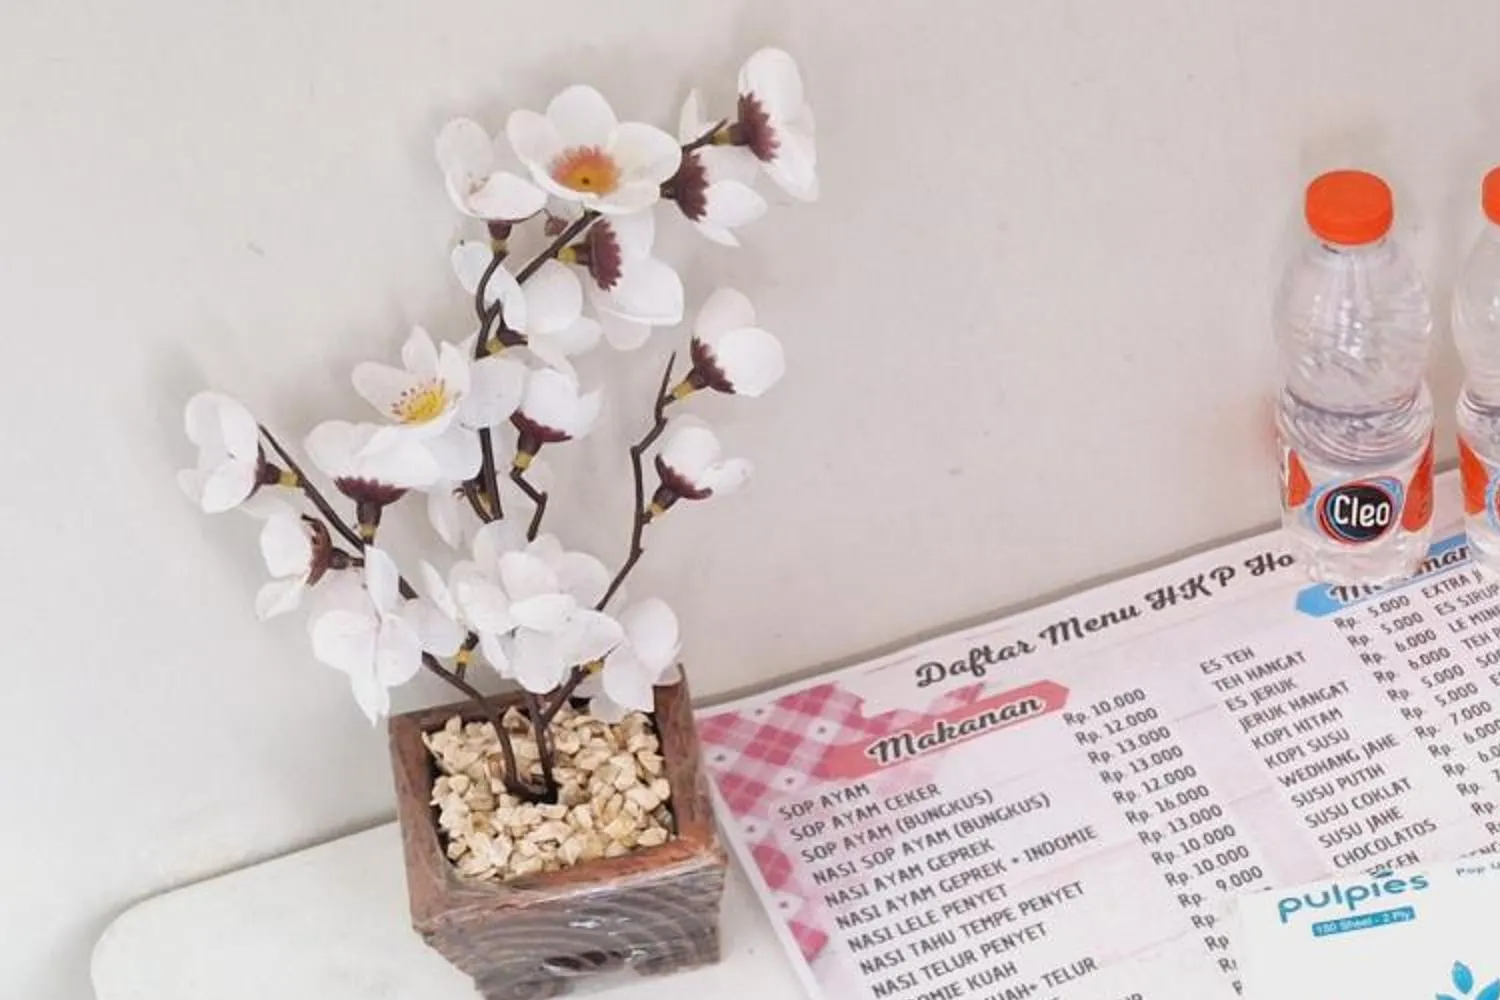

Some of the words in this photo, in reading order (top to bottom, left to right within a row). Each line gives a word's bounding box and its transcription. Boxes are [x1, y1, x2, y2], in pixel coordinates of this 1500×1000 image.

[1334, 495, 1389, 527] Cleo
[1421, 574, 1470, 599] EXTRA
[1433, 601, 1456, 616] ES
[1456, 583, 1500, 607] SIRUP
[1447, 617, 1468, 633] LE
[1460, 631, 1492, 650] TEH
[914, 641, 1036, 688] Daftar
[1039, 602, 1143, 647] Menu
[1199, 659, 1222, 675] ES
[1223, 647, 1255, 665] TEH
[1211, 673, 1244, 692] TEH
[1244, 651, 1305, 680] HANGAT
[1090, 688, 1146, 716] 10.000
[1224, 695, 1248, 712] ES
[1249, 677, 1297, 706] JERUK
[1238, 704, 1287, 733] JERUK
[1287, 680, 1348, 711] HANGAT
[867, 695, 1043, 764] Makanan
[1104, 707, 1158, 735] 12.000
[1116, 726, 1171, 754] 13.000
[1251, 726, 1292, 749] KOPI
[1292, 707, 1343, 733] HITAM
[1129, 745, 1183, 773] 13.000
[1263, 745, 1306, 769] KOPI
[1306, 727, 1350, 752] SUSU
[1278, 749, 1360, 787] WEDHANG
[1361, 733, 1398, 760] JAHE
[1141, 765, 1196, 793] 12.000
[1155, 784, 1209, 813] 16.000
[1291, 782, 1335, 808] SUSU
[1335, 763, 1385, 789] PUTIH
[778, 799, 814, 821] SOP
[820, 783, 870, 808] AYAM
[789, 821, 825, 841] SOP
[831, 802, 881, 829] AYAM
[883, 783, 940, 811] CEKER
[1167, 804, 1222, 833] 13.000
[1304, 802, 1349, 828] SUSU
[1351, 777, 1411, 810] COKLAT
[800, 841, 837, 863] SOP
[843, 823, 892, 850] AYAM
[895, 789, 993, 833] (BUNGKUS)
[812, 861, 857, 885] NASI
[860, 847, 895, 869] SOP
[901, 828, 951, 856] AYAM
[953, 793, 1050, 838] (BUNGKUS)
[1179, 824, 1236, 854] 10.000
[1318, 822, 1363, 848] SUSU
[1365, 806, 1403, 833] JAHE
[1333, 819, 1436, 868] CHOCOLATOS
[823, 883, 869, 908] NASI
[873, 863, 924, 891] AYAM
[926, 838, 994, 872] GEPREK
[835, 904, 881, 929] NASI
[885, 885, 936, 913] AYAM
[938, 859, 1007, 893] GEPREK
[1024, 826, 1096, 862] INDOMIE
[1193, 845, 1249, 875] 10.000
[1215, 865, 1263, 891] 9.000
[847, 926, 893, 952] NASI
[895, 909, 939, 935] LELE
[941, 883, 1007, 918] PENYET
[1277, 873, 1429, 923] pulpies
[859, 949, 905, 974] NASI
[908, 930, 956, 956] TAHU
[959, 907, 1016, 937] TEMPE
[1017, 881, 1083, 916] PENYET
[871, 972, 918, 998] NASI
[919, 949, 978, 980] TELUR
[979, 922, 1046, 957] PENYET
[965, 961, 1017, 990] KUAH
[1041, 957, 1097, 987] TELUR
